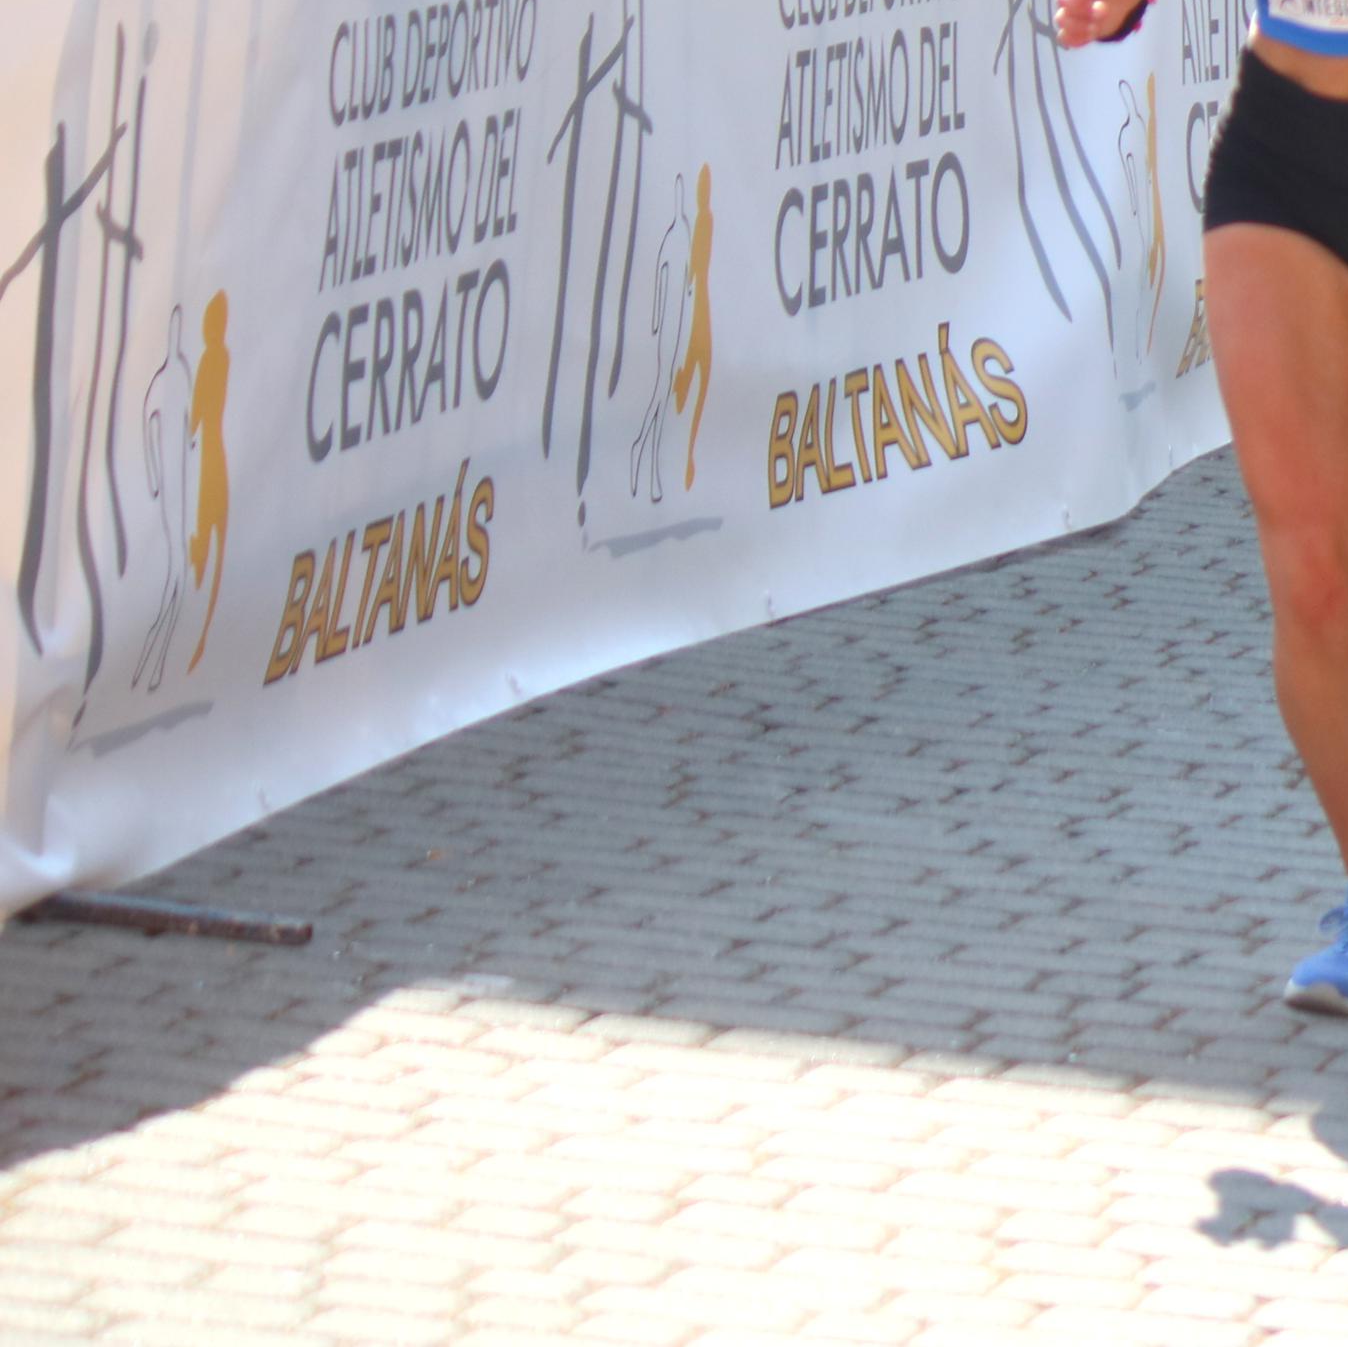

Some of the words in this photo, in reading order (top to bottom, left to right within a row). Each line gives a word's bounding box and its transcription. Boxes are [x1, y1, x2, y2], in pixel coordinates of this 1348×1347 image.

[329, 12, 396, 127] CLUB
[775, 28, 909, 170] ATLETISMO
[919, 21, 966, 137] DEL
[318, 119, 471, 294] ATLETISMO
[474, 107, 521, 244] DEL
[774, 150, 970, 317] CERRATO
[306, 258, 510, 463] CERRATO
[768, 320, 1028, 510] BALTANÁS
[262, 457, 495, 688] BALTANÁS
